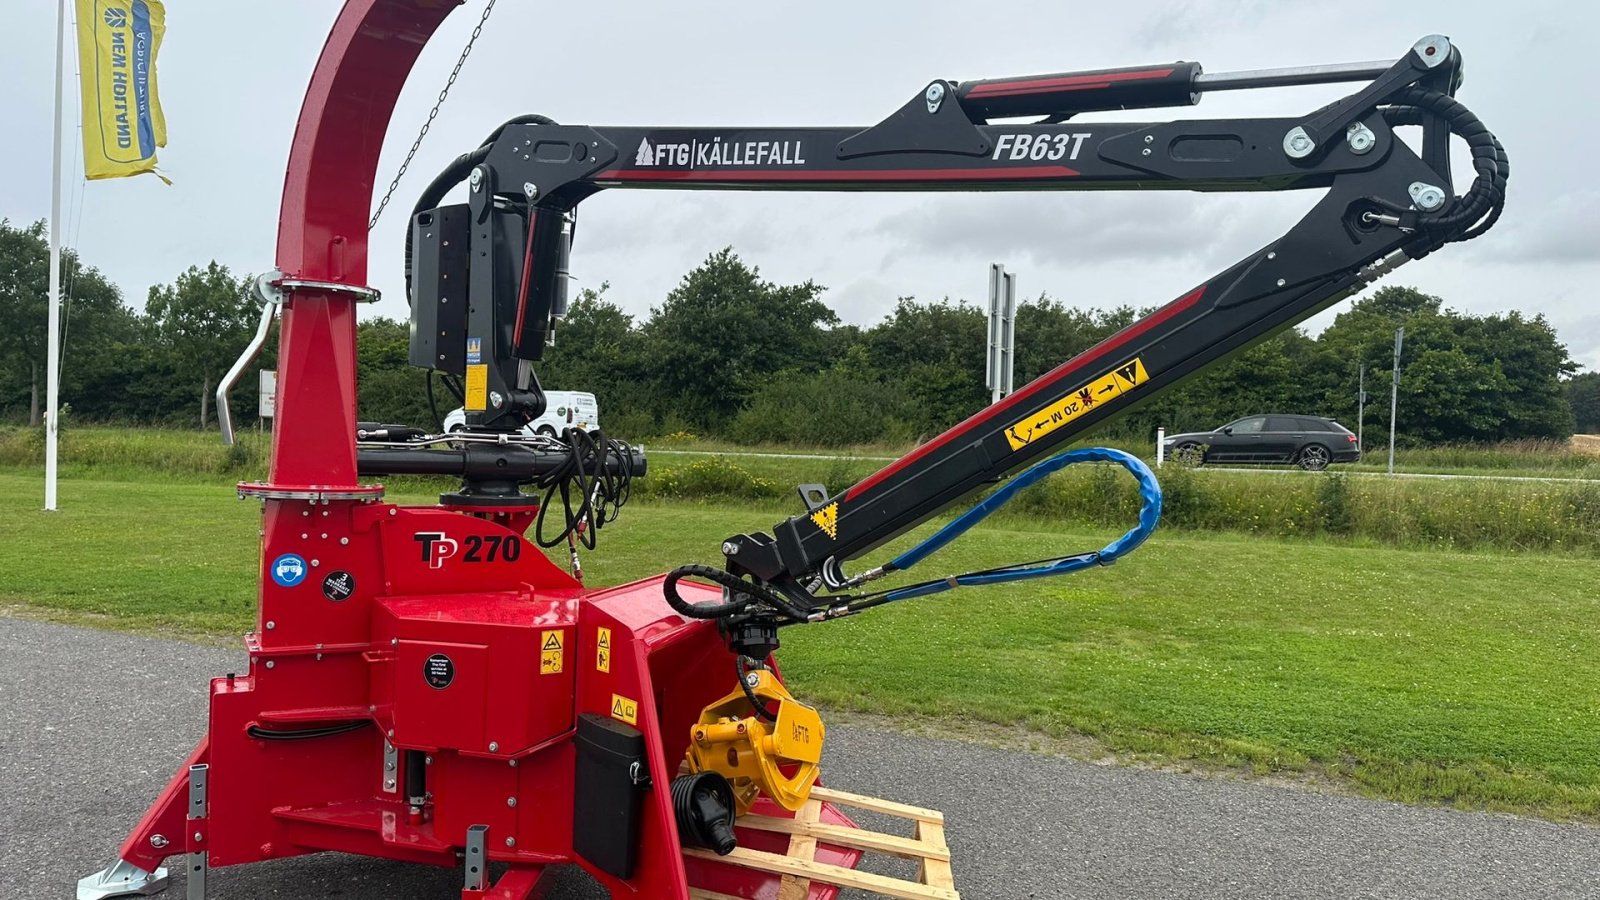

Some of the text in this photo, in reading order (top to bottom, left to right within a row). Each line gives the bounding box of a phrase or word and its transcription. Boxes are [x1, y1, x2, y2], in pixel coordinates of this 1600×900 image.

[655, 137, 806, 165] FTG KÄLLEFALL
[992, 133, 1092, 160] FB63T
[1050, 401, 1079, 424] 20 M
[414, 532, 521, 569] TP 270
[340, 573, 348, 581] 3
[798, 725, 809, 744] FTG
